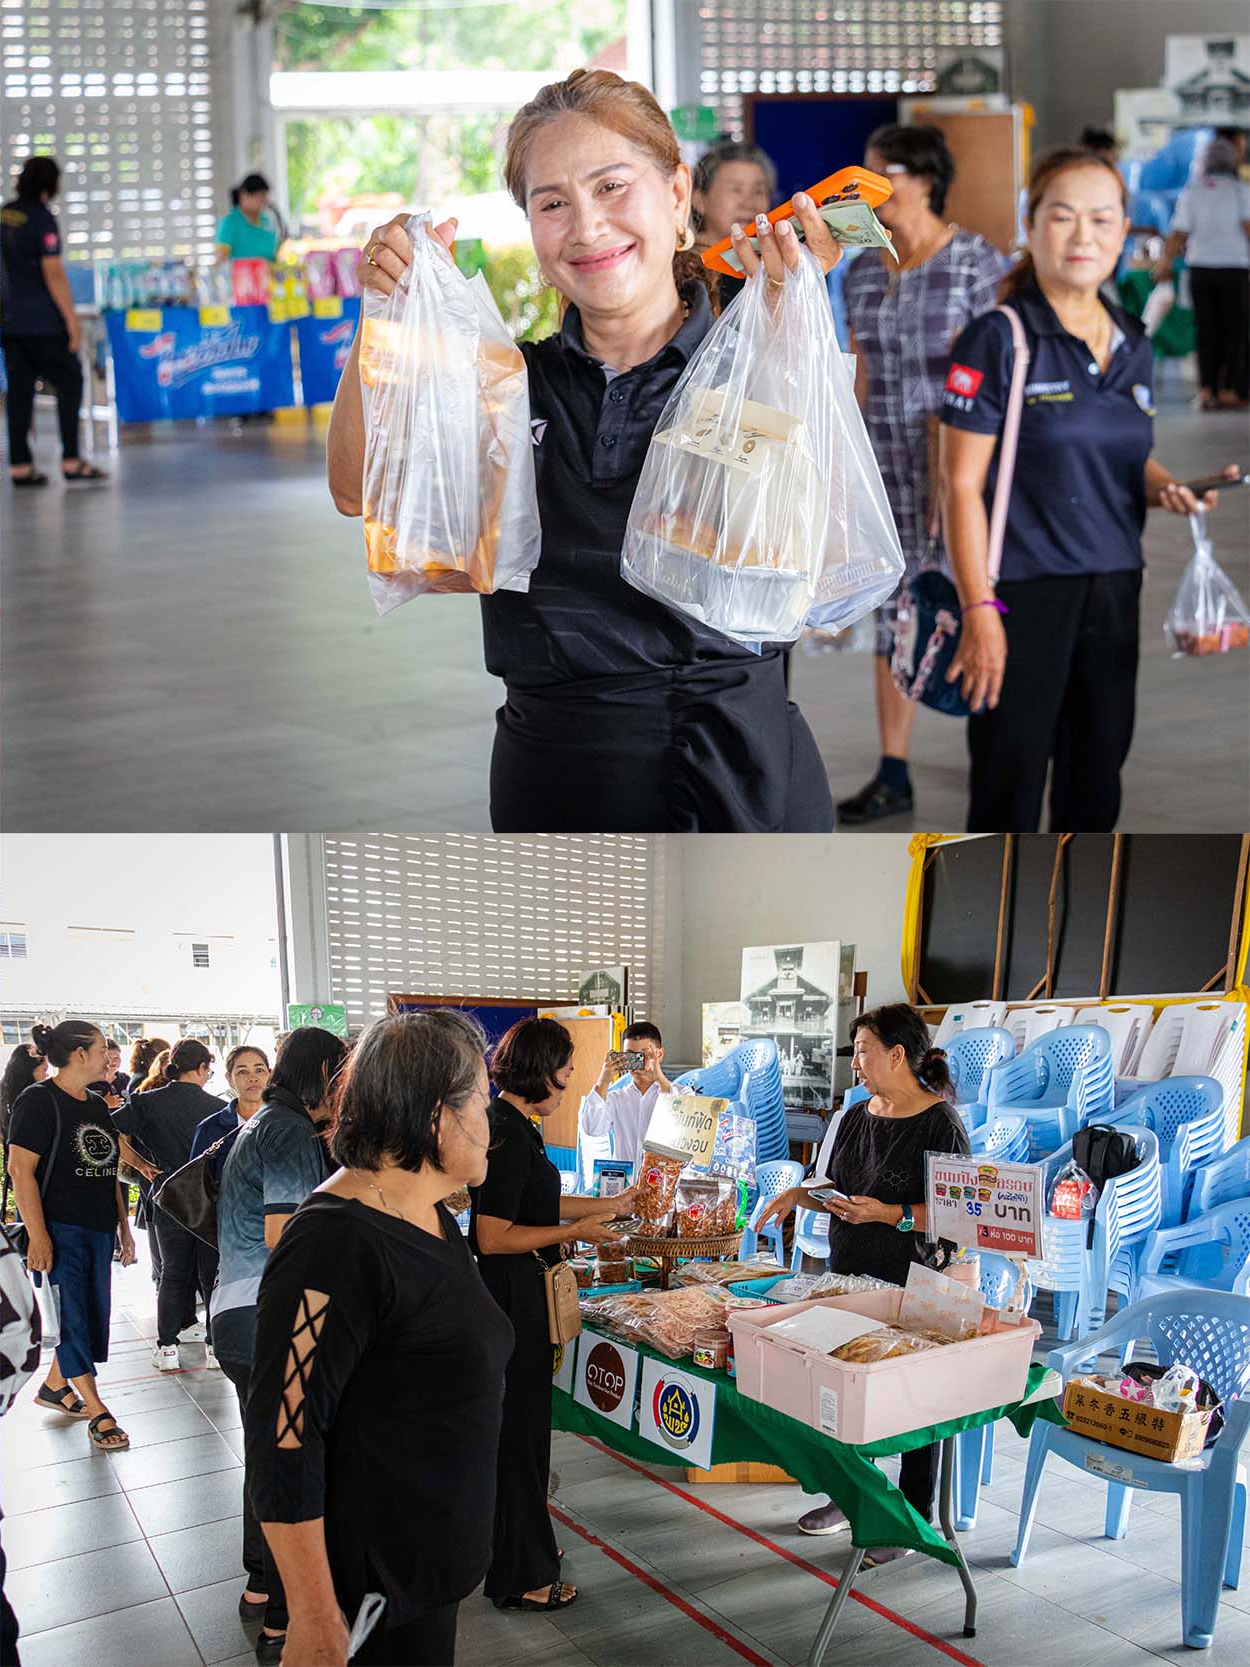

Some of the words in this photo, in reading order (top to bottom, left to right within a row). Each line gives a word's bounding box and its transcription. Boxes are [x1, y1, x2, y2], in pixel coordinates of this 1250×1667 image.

[75, 1167, 117, 1177] CELINE
[934, 1170, 978, 1186] ขนมปัง
[995, 1178, 1033, 1192] กรอบ
[935, 1197, 957, 1208] ราคา
[965, 1201, 983, 1217] 35
[994, 1203, 1031, 1222] บาท
[1003, 1231, 1016, 1241] 100
[587, 1363, 624, 1392] OTOP
